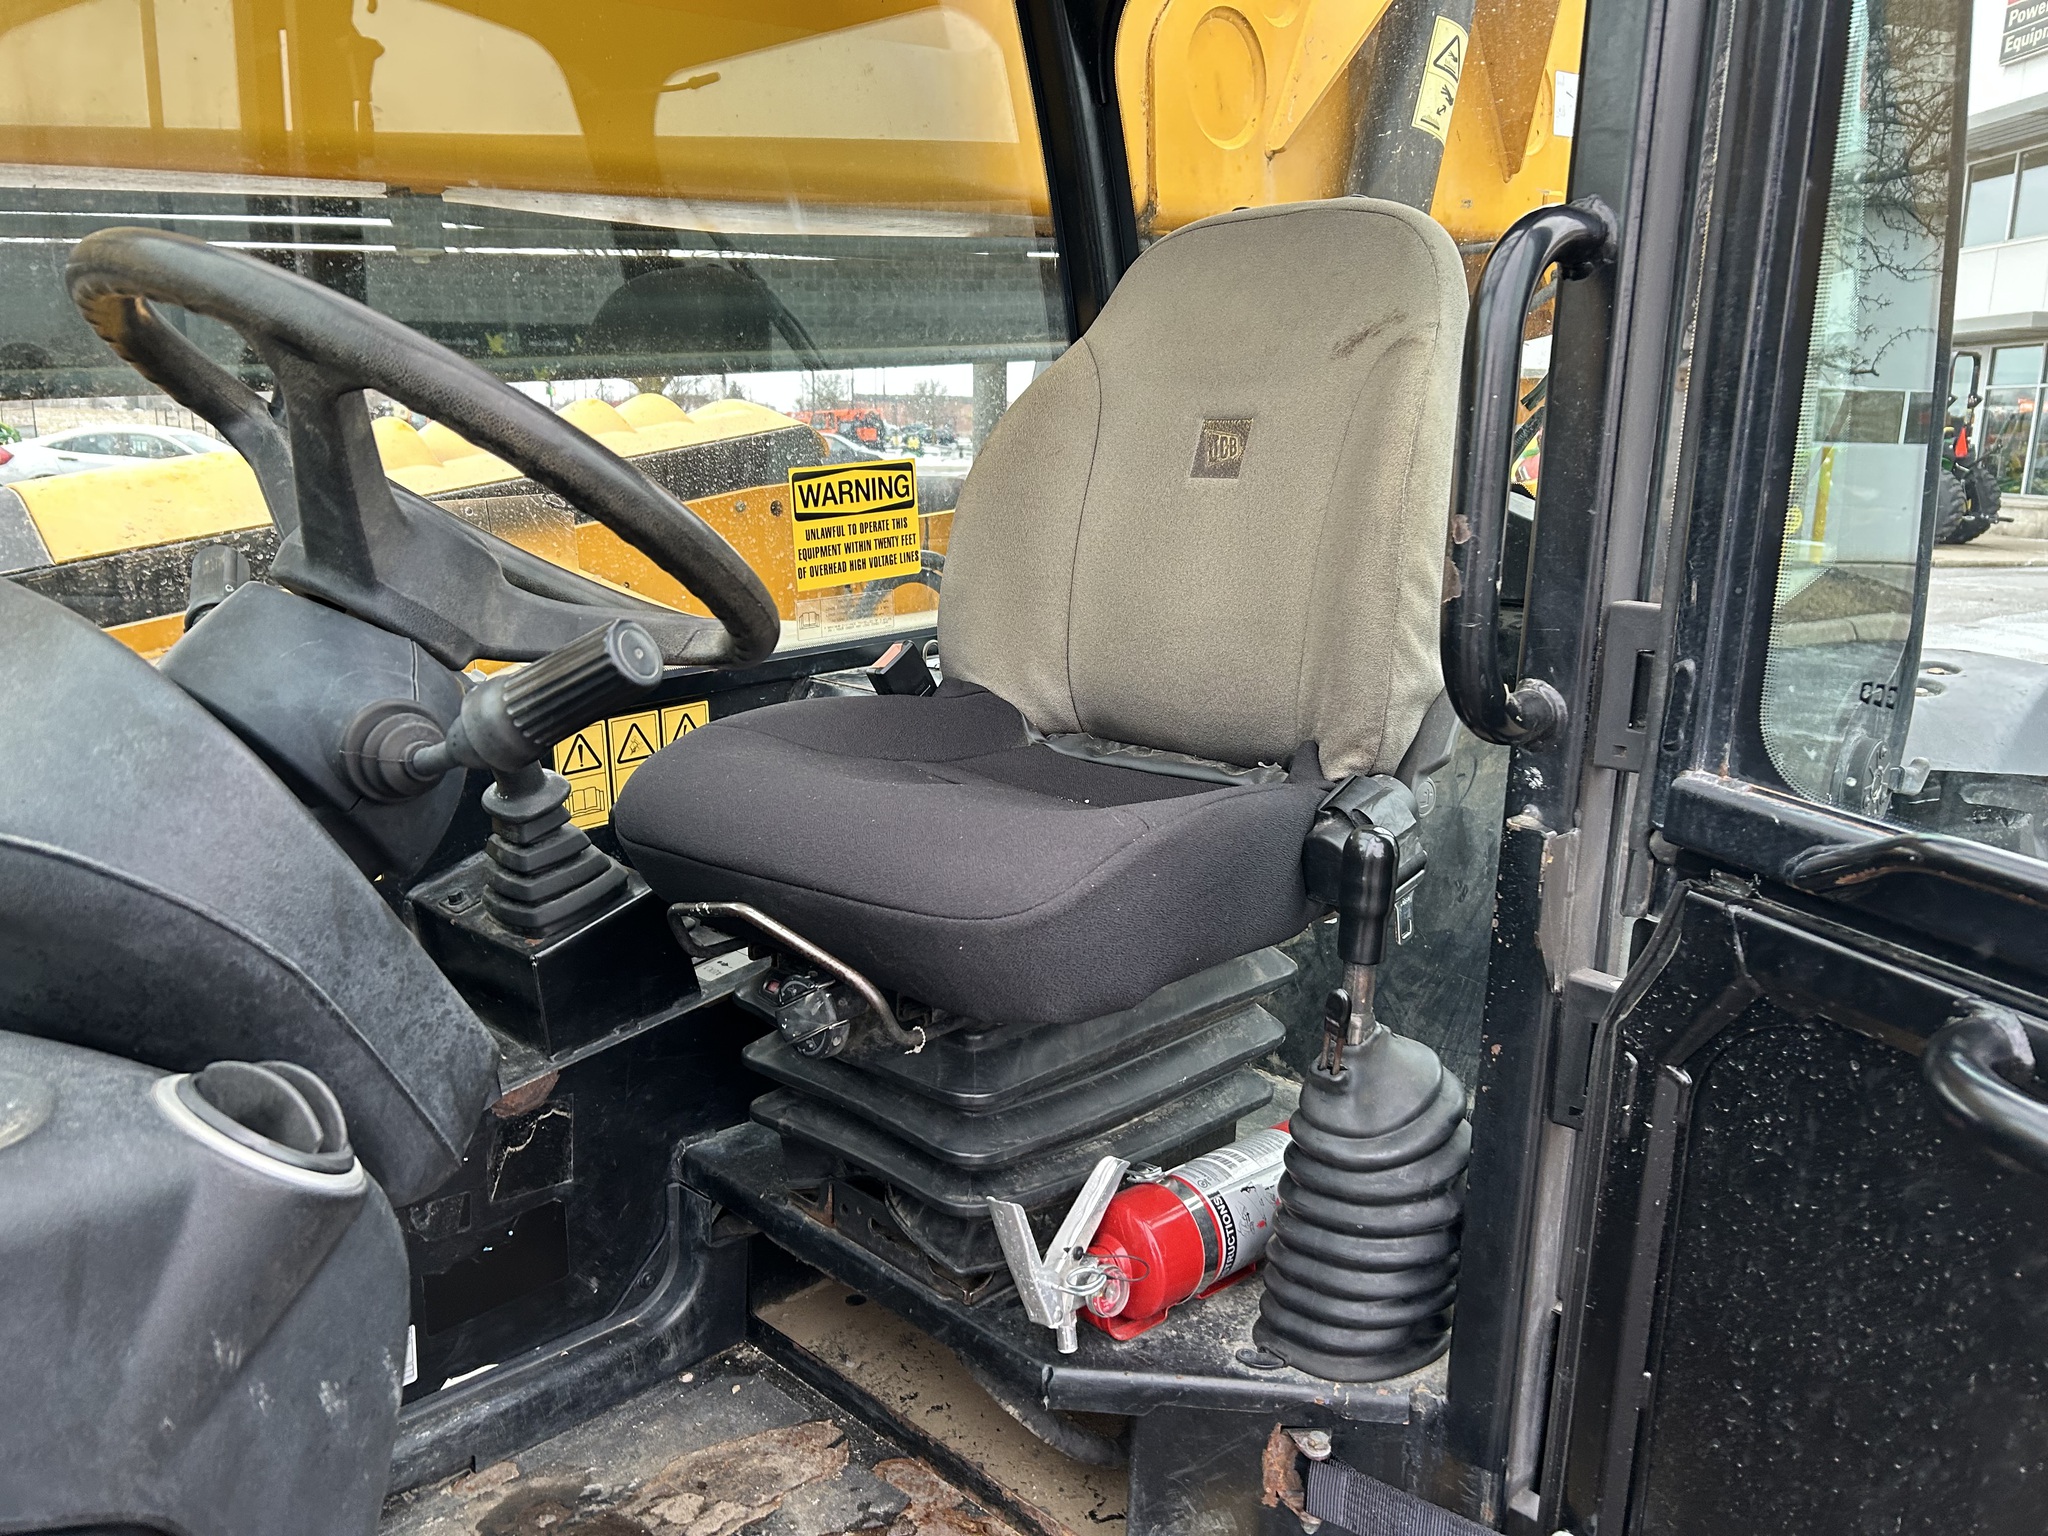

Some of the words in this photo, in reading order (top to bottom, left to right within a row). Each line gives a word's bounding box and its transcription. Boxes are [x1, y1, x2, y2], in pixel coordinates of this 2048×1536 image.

[1207, 433, 1239, 463] JCB
[798, 474, 910, 508] WARNING
[805, 525, 846, 541] UNLAWFUL
[847, 524, 858, 536] TO
[859, 521, 890, 534] OPERATE
[891, 516, 908, 530] THIS
[798, 543, 842, 562] EQUIPMENT
[844, 538, 872, 555] WITHIN
[873, 535, 900, 550] TWENTY
[901, 533, 917, 546] FEET
[797, 567, 808, 580] OF
[809, 561, 848, 577] OVERHEAD
[849, 558, 867, 572] HIGH
[868, 553, 898, 569] VOLTAGE
[899, 550, 920, 564] LINES
